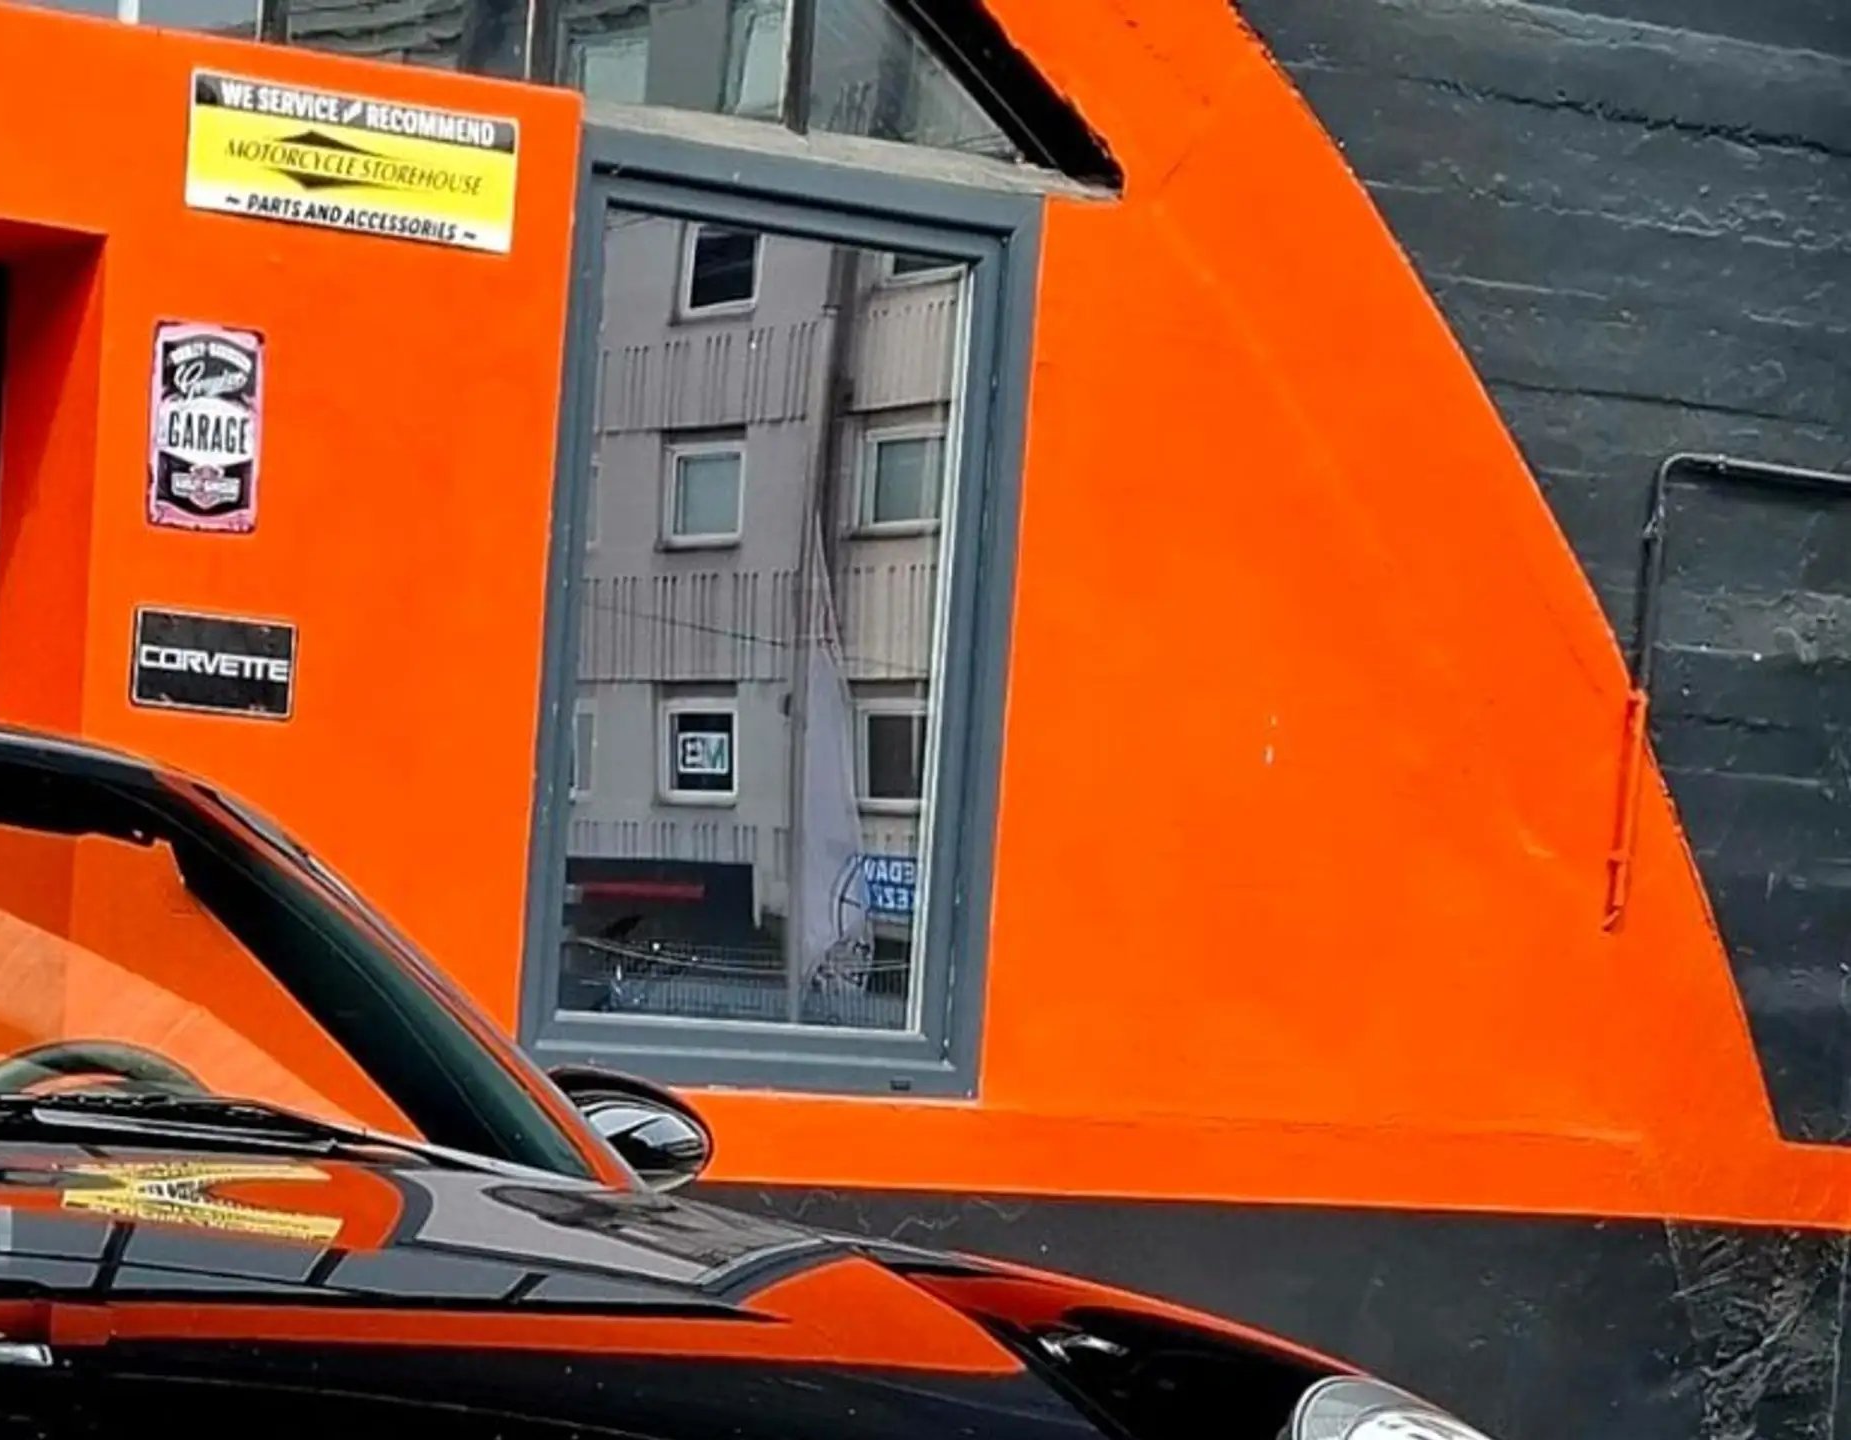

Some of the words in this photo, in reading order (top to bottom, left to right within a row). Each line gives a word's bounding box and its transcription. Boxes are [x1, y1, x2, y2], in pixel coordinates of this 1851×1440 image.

[220, 80, 256, 110] WE
[256, 86, 339, 122] SERVICE
[365, 103, 495, 146] RECOMMEND
[224, 138, 358, 177] MOTORCYCLE
[359, 159, 483, 196] STOREHOUSE
[247, 193, 302, 218] PARTS
[303, 202, 342, 223] AND
[343, 208, 457, 241] ACCESSORIES
[167, 411, 249, 455] GARAGE
[139, 644, 290, 683] CORVETTE
